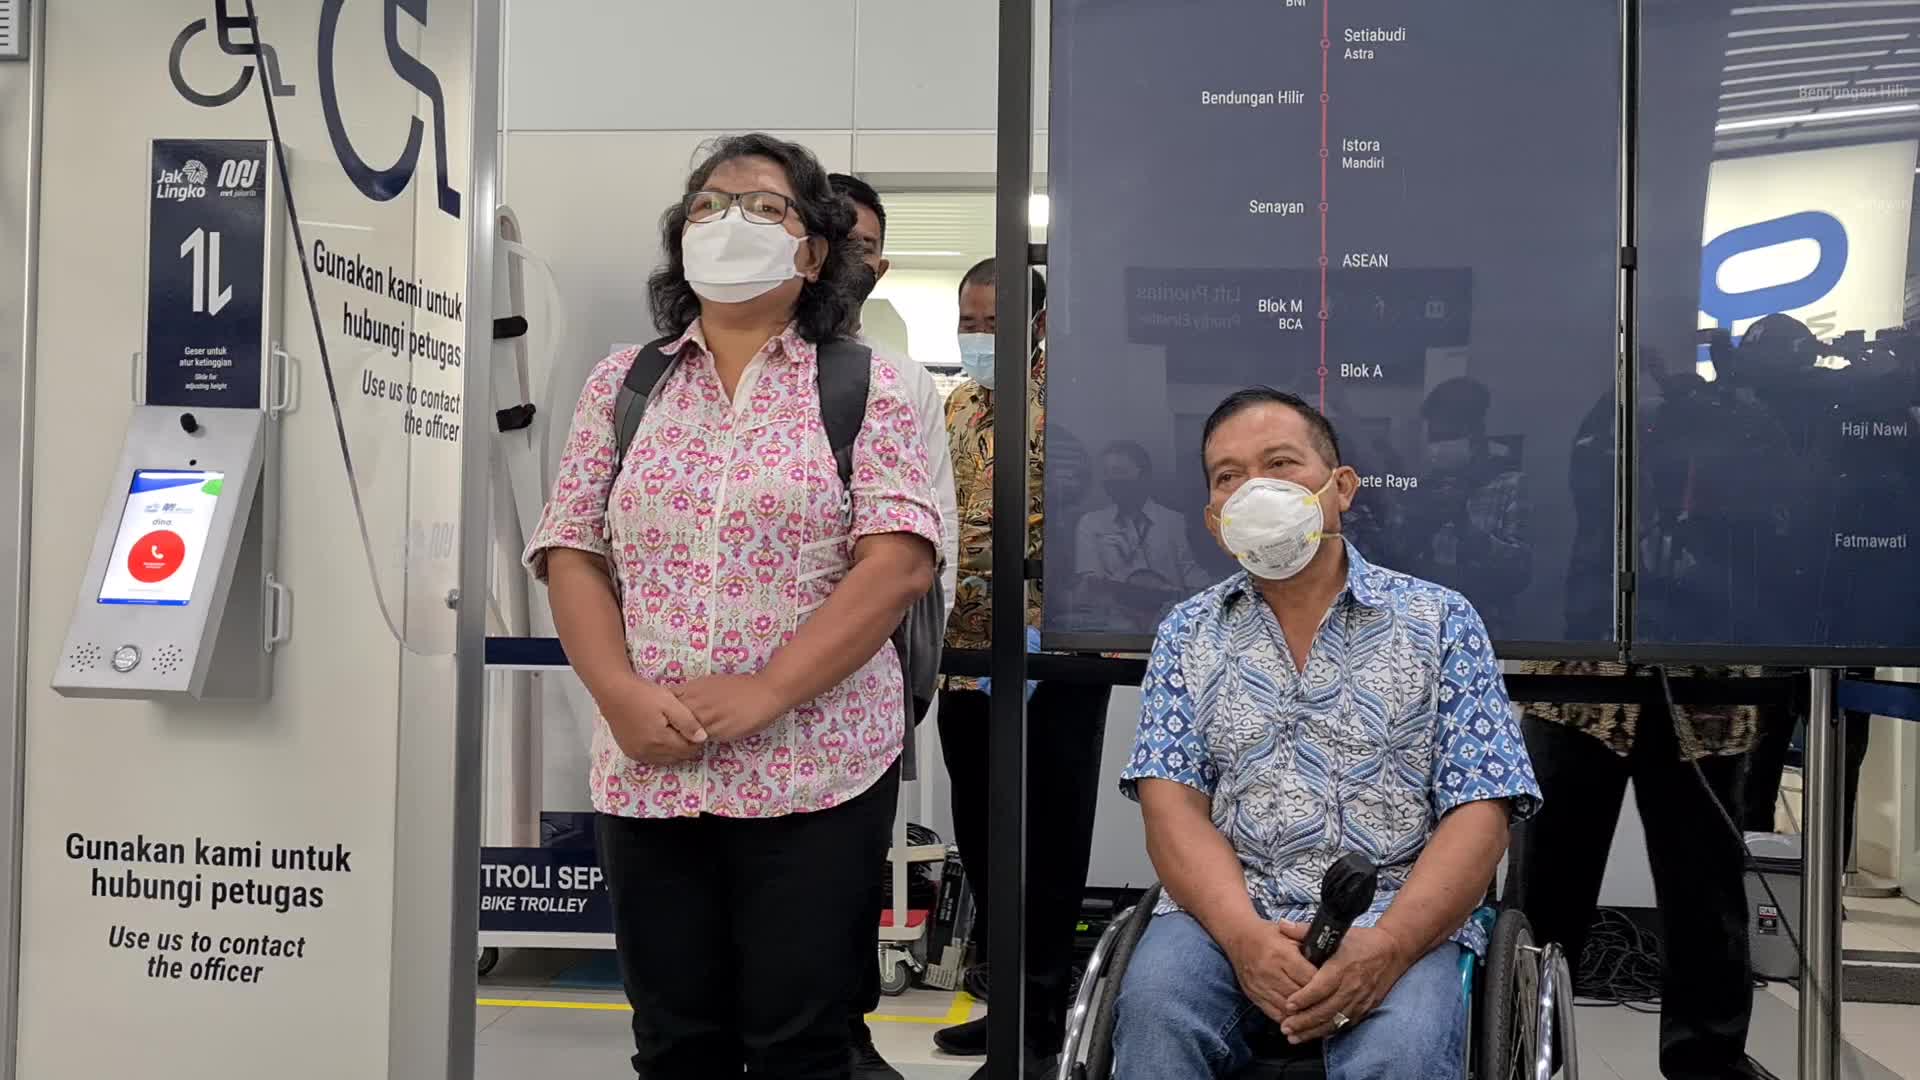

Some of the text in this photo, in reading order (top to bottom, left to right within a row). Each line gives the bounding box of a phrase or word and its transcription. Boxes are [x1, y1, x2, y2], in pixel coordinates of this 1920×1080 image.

[1344, 27, 1406, 42] Setiabudi
[1344, 48, 1374, 60] Astra
[1202, 90, 1305, 108] Bendungan Hilir
[1342, 138, 1380, 152] Istora
[1342, 156, 1385, 169] Mandiri
[157, 169, 183, 184] Jak
[156, 184, 206, 202] Lingko
[1249, 199, 1305, 217] Senayan
[1342, 253, 1389, 268] ASEAN
[313, 239, 462, 322] Gunakan kami untuk
[1258, 298, 1303, 313] Blok M
[1278, 318, 1303, 330] BCA
[343, 301, 461, 371] hubungi petugas
[1340, 363, 1383, 378] Blok A
[361, 369, 461, 415] Use us to contact
[404, 410, 460, 442] the officer
[1841, 421, 1908, 439] Haji Nawi
[1386, 473, 1418, 491] Raya
[1834, 533, 1907, 548] Fatmawati
[65, 832, 352, 872] Gunakan kami untuk
[480, 864, 609, 891] TROLI SEP
[91, 867, 324, 913] hubungi petugas
[480, 895, 587, 913] BIKE TROLLEY
[108, 925, 305, 958] Use us to contact
[147, 954, 263, 983] the officer
